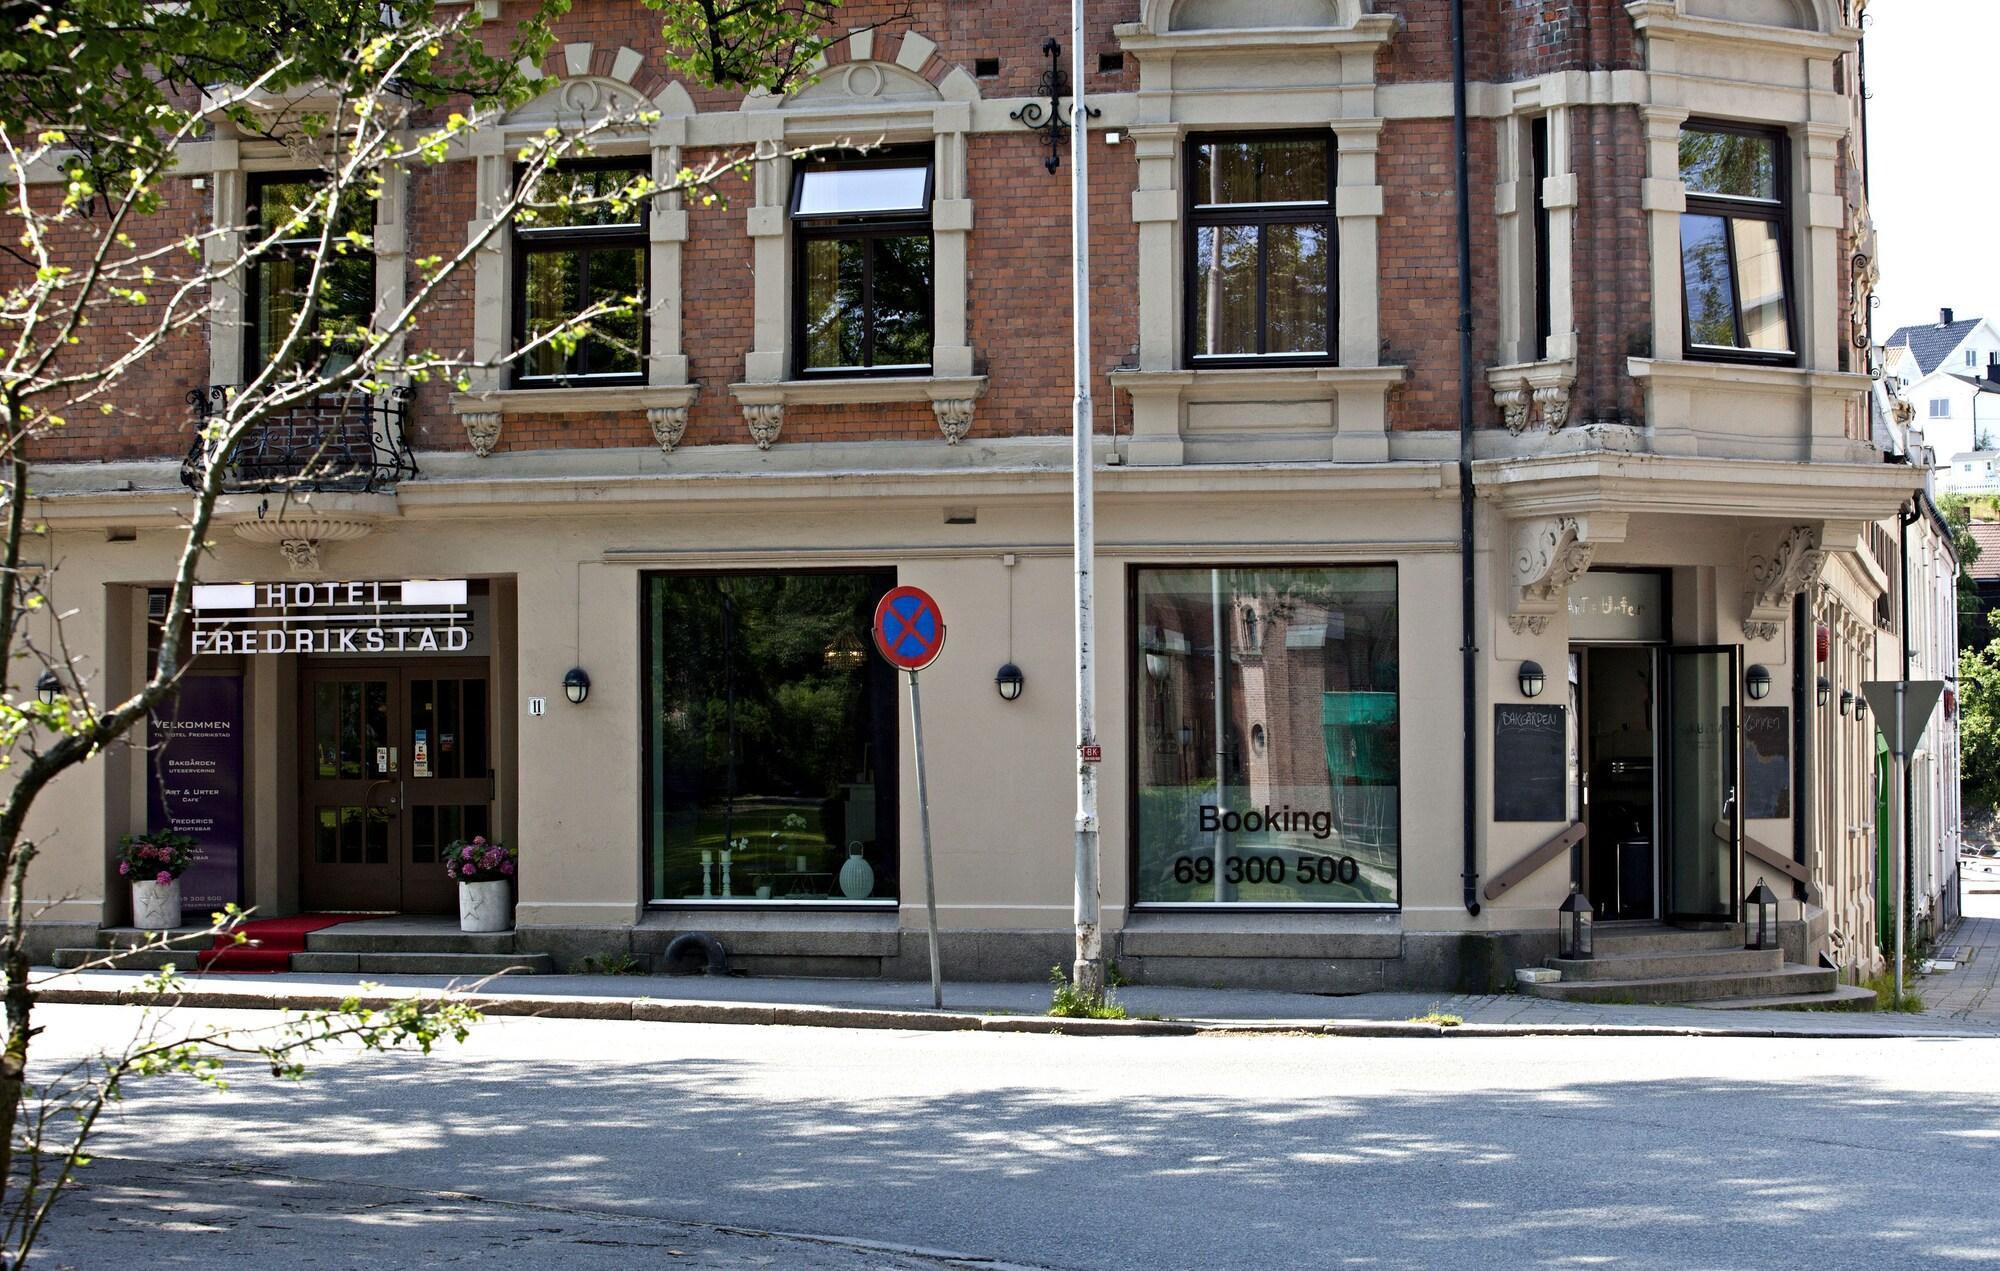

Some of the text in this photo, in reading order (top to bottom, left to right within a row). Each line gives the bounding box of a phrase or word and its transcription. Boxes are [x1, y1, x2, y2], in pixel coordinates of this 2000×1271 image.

[266, 582, 389, 608] HOTEL
[191, 626, 469, 655] FREDRIKSTAD
[153, 720, 231, 729] VELKOMMEN
[168, 758, 216, 766] BAKGÅRDEN
[1199, 805, 1331, 839] Booking
[1174, 856, 1360, 885] 69 300 500
